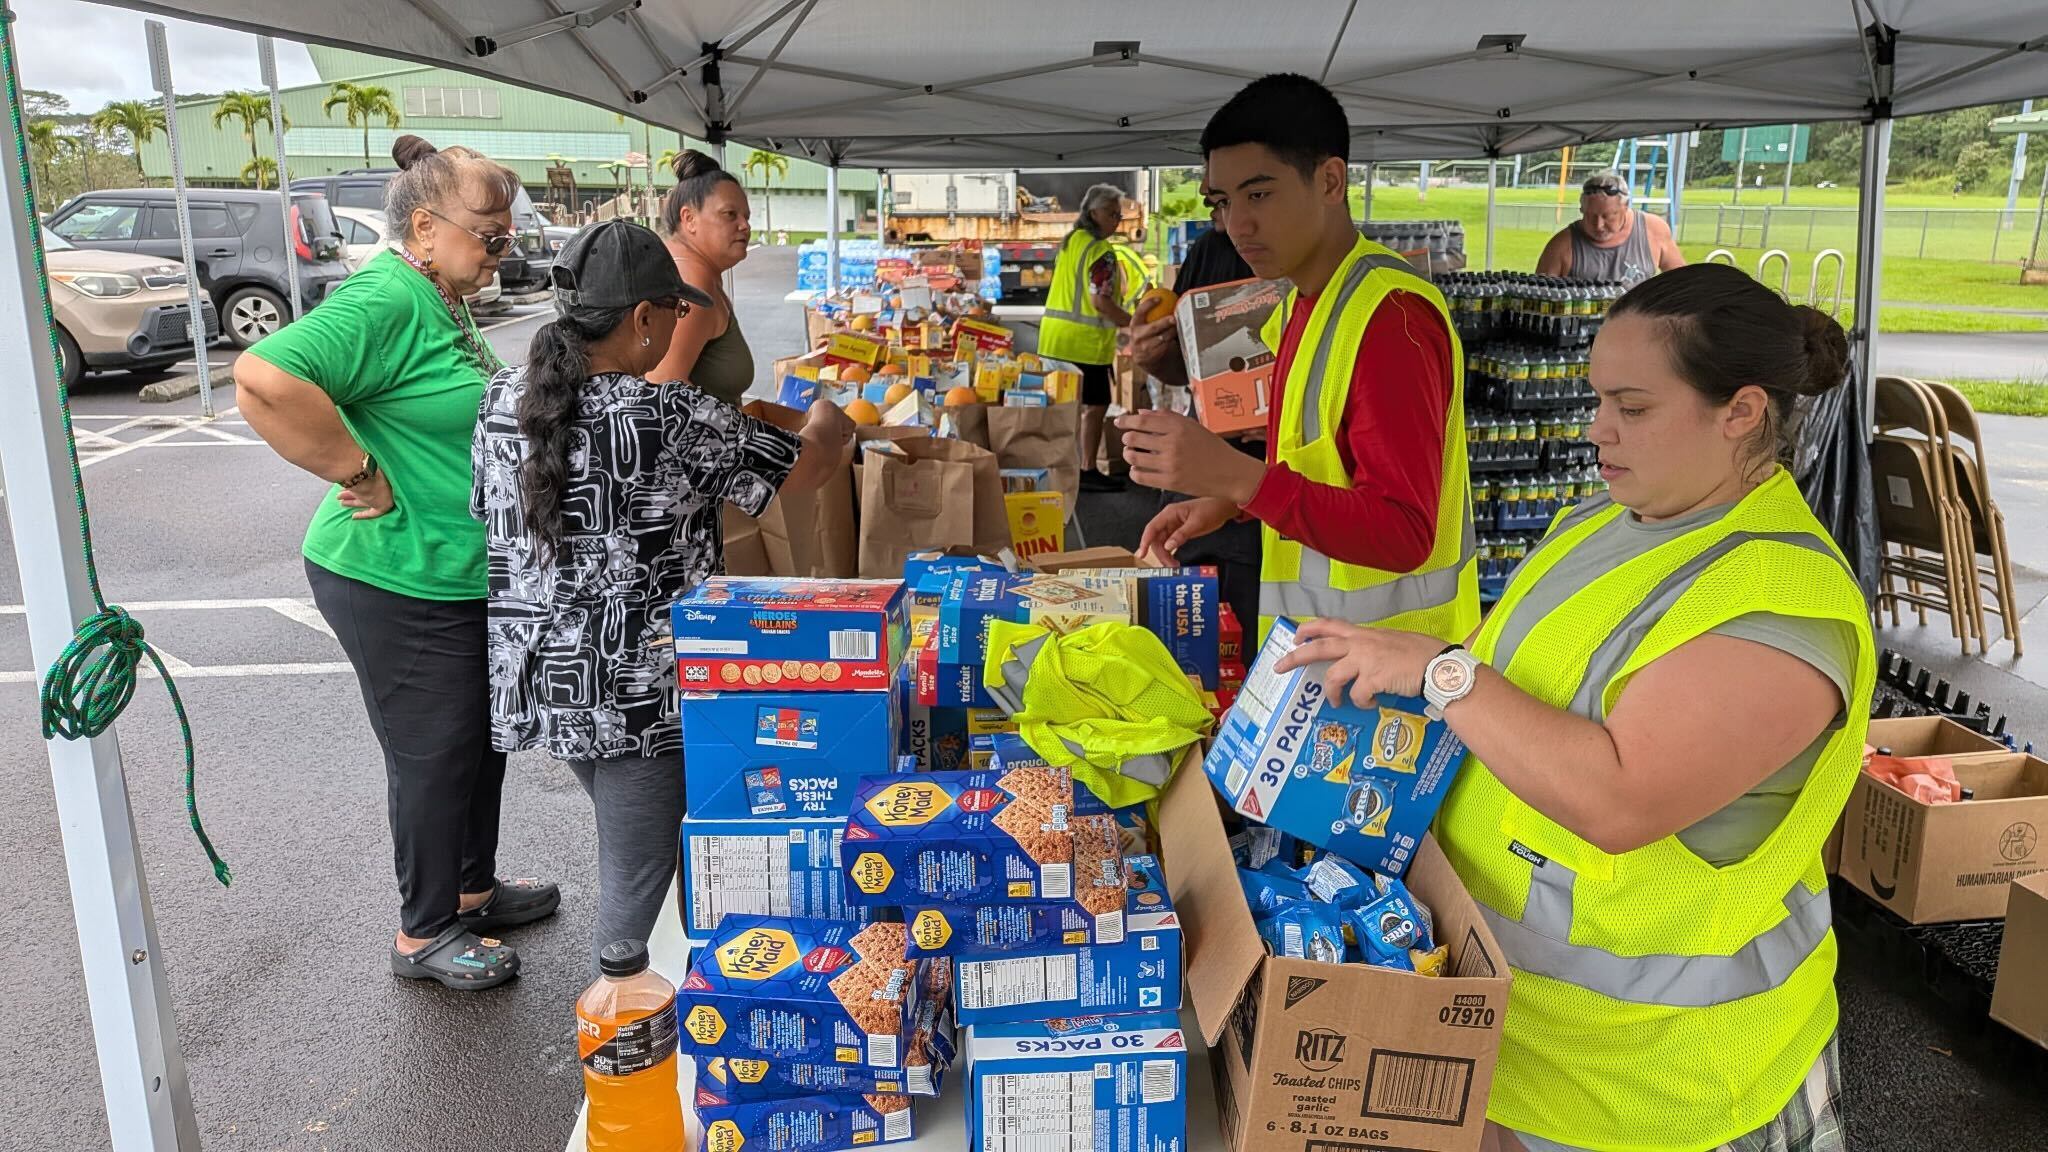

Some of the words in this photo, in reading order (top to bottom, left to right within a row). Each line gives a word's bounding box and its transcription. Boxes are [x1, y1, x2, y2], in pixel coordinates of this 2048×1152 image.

[1176, 585, 1189, 604] the
[1191, 583, 1205, 620] baked
[753, 611, 798, 621] HEROES
[1176, 608, 1188, 637] USA
[942, 623, 950, 648] party
[949, 626, 957, 644] size
[1192, 621, 1202, 637] in
[1219, 643, 1239, 655] RITZ
[920, 670, 928, 697] family
[961, 666, 971, 703] triscuit
[1260, 756, 1286, 788] 30
[1283, 680, 1323, 753] PACKS
[1384, 717, 1401, 762] OREO
[1007, 757, 1046, 770] proud
[789, 777, 838, 790] PACKS
[795, 792, 832, 801] THESE
[885, 786, 917, 822] Honey
[908, 790, 933, 818] Maid
[1354, 783, 1371, 825] OREO
[803, 802, 826, 812] TRY
[863, 856, 876, 889] Honey
[873, 861, 885, 887] Maid
[1956, 871, 2014, 887] HUMANITARIAN
[922, 914, 933, 948] Honey
[931, 919, 943, 946] Maid
[1382, 919, 1414, 944] OREO
[727, 931, 772, 975] Honey
[751, 940, 786, 974] Maid
[961, 963, 969, 980] Facts
[983, 962, 991, 974] 120
[962, 982, 970, 1008] Nutrition
[1454, 995, 1485, 1006] 44000
[696, 1008, 709, 1040] Honey
[1438, 1006, 1495, 1026] 07970
[617, 1023, 643, 1032] Nutrition
[706, 1014, 718, 1039] Maid
[1016, 1037, 1101, 1053] PACKS
[1111, 1034, 1145, 1048] 30
[1295, 1029, 1347, 1063] RITZ
[593, 1054, 612, 1067] 50%
[593, 1063, 613, 1072] MORE
[739, 1060, 751, 1080] Hon
[750, 1059, 760, 1078] Mai
[1007, 1075, 1015, 1088] 110
[1272, 1072, 1326, 1090] Toasted
[1327, 1078, 1361, 1091] CHIPS
[1292, 1094, 1337, 1105] roasted
[1296, 1102, 1330, 1113] garlic
[1266, 1121, 1275, 1132] 6
[1289, 1121, 1318, 1134] 8.1
[1324, 1126, 1344, 1137] OZ
[1349, 1127, 1389, 1140] BAGS
[724, 1129, 735, 1152] Maid
[984, 1136, 992, 1151] Facts
